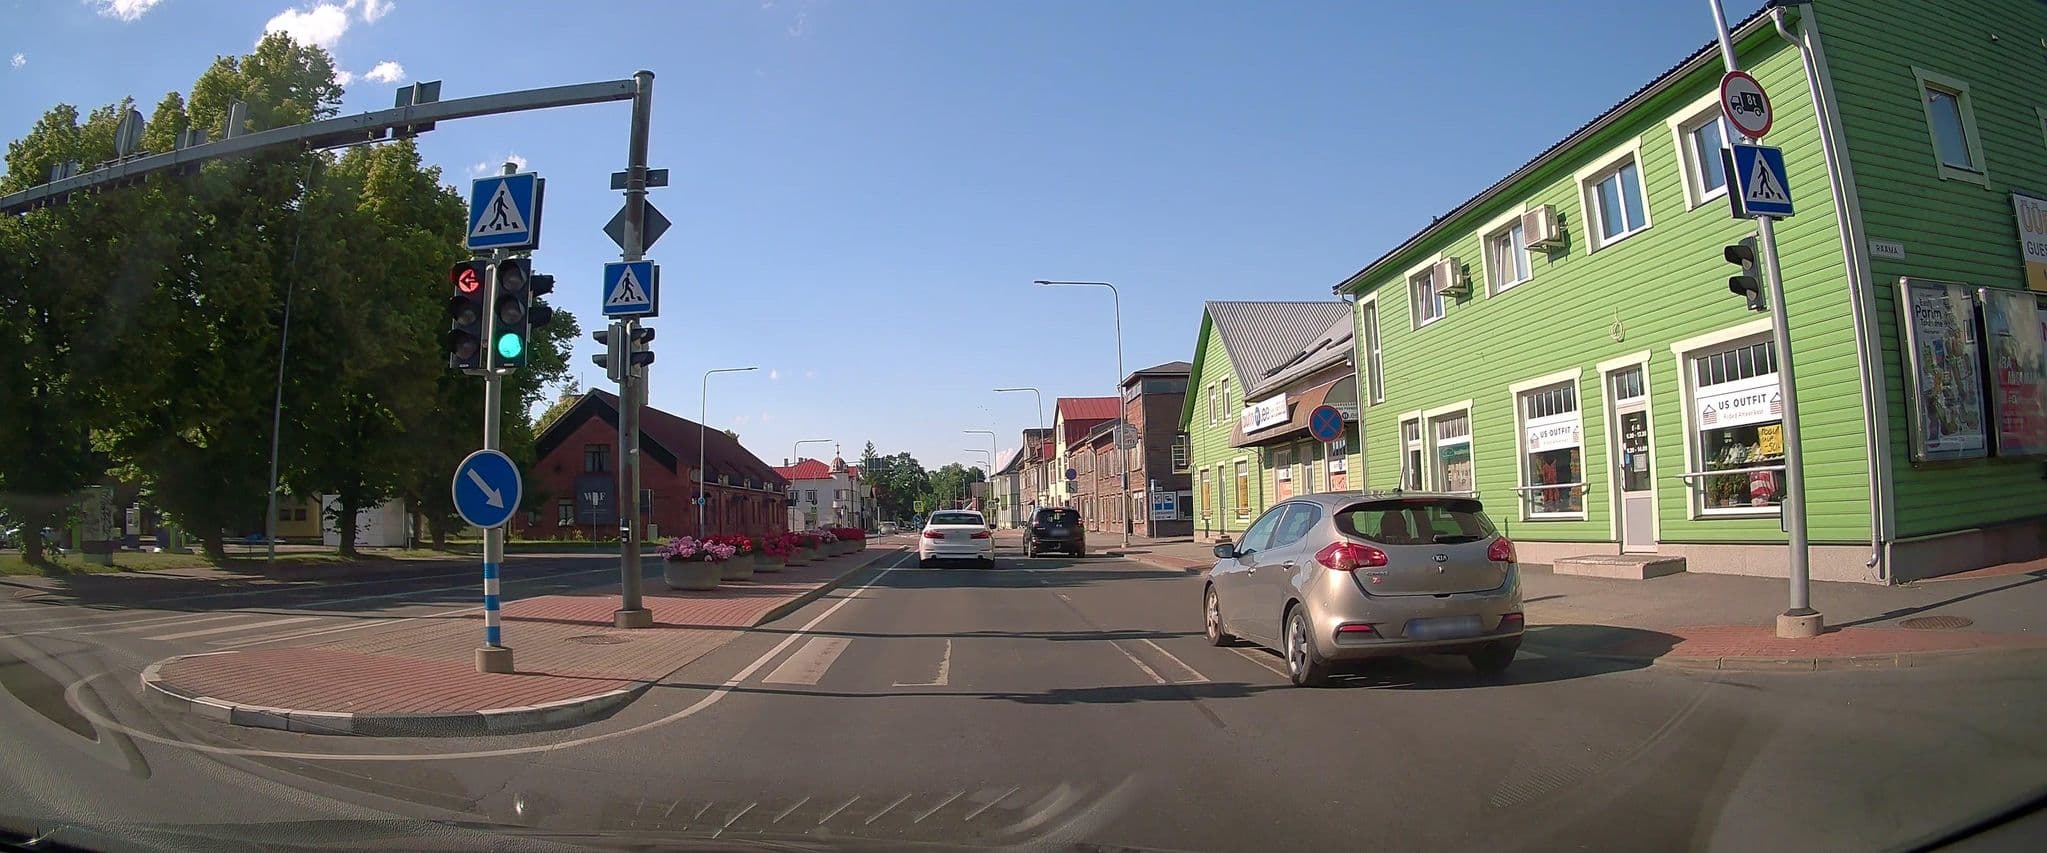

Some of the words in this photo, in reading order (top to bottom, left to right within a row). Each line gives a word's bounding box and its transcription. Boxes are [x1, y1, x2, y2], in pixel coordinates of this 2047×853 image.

[1746, 94, 1757, 106] 8t
[1719, 400, 1730, 410] US
[1733, 393, 1767, 408] OUTFIT
[1539, 430, 1548, 438] US
[1549, 426, 1571, 437] OUTFIT
[1435, 554, 1448, 562] KIA
